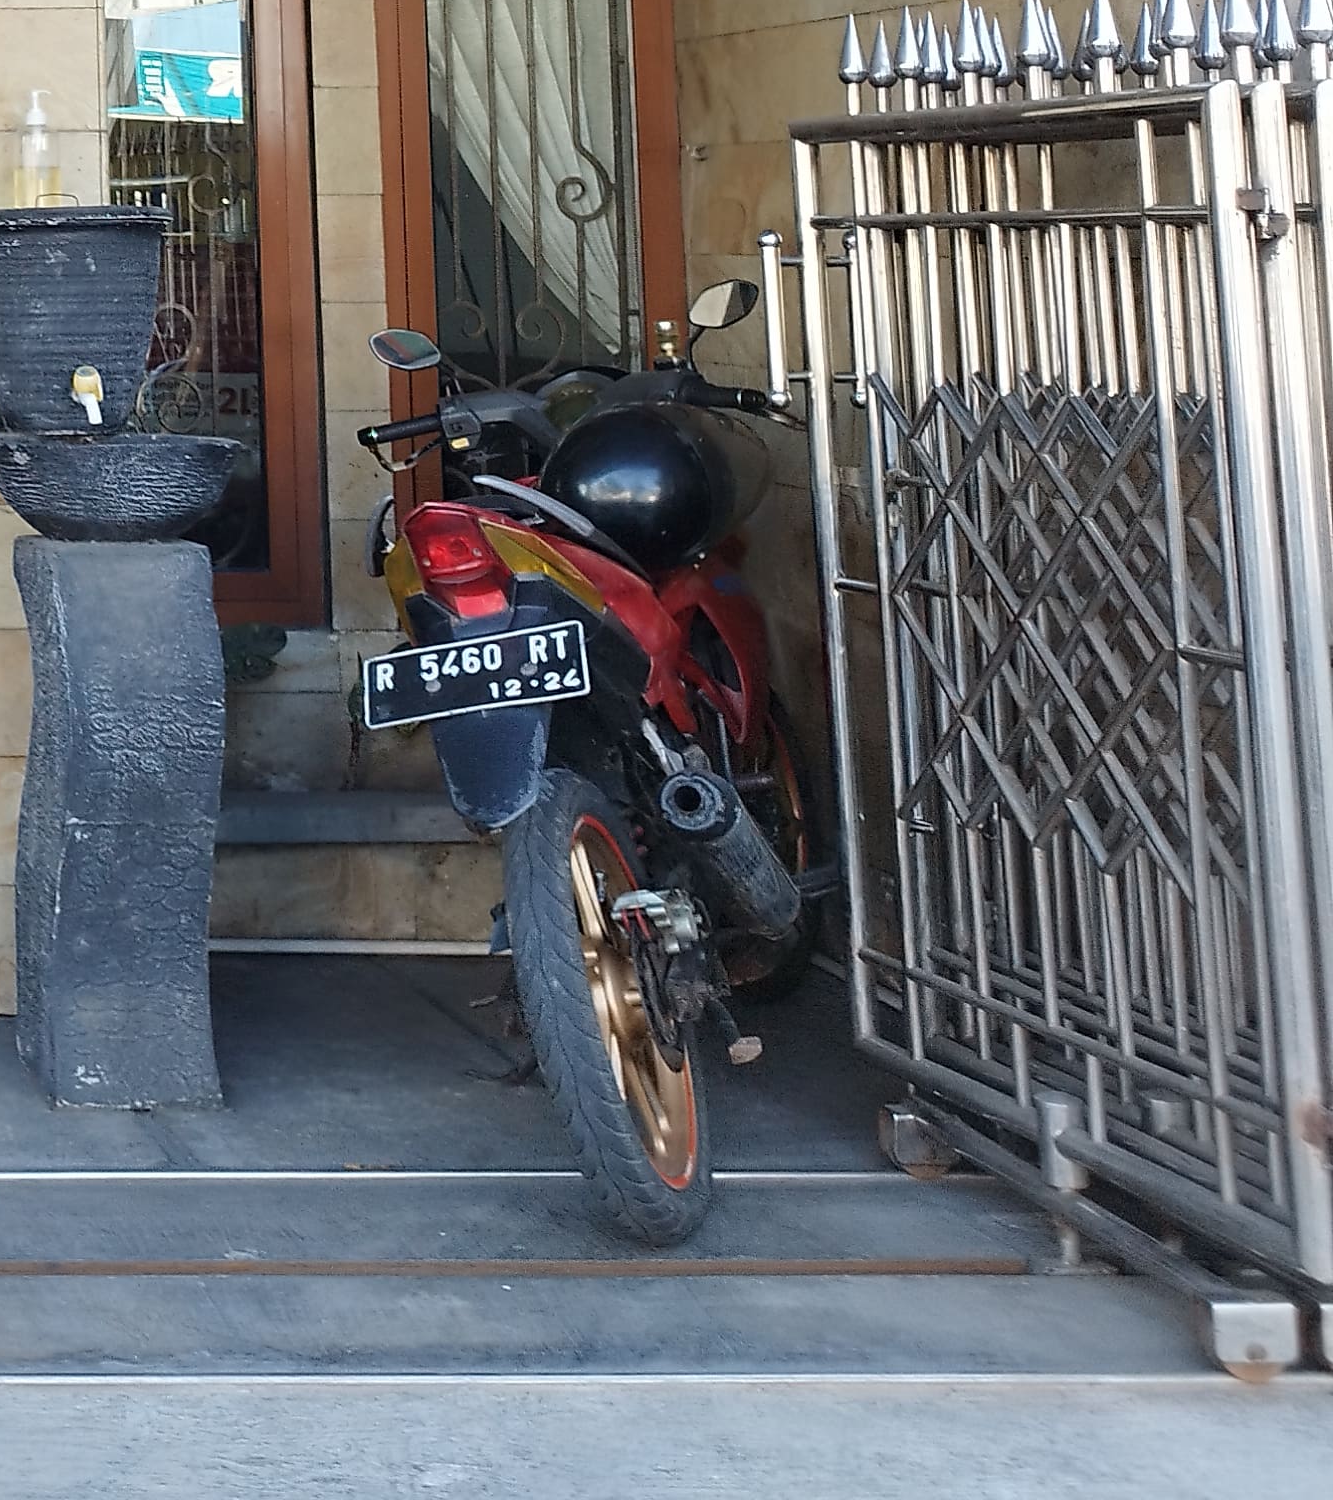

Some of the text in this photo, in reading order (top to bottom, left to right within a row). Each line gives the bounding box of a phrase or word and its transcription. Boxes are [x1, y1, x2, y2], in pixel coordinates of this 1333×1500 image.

[375, 630, 569, 693] R 5460 RT
